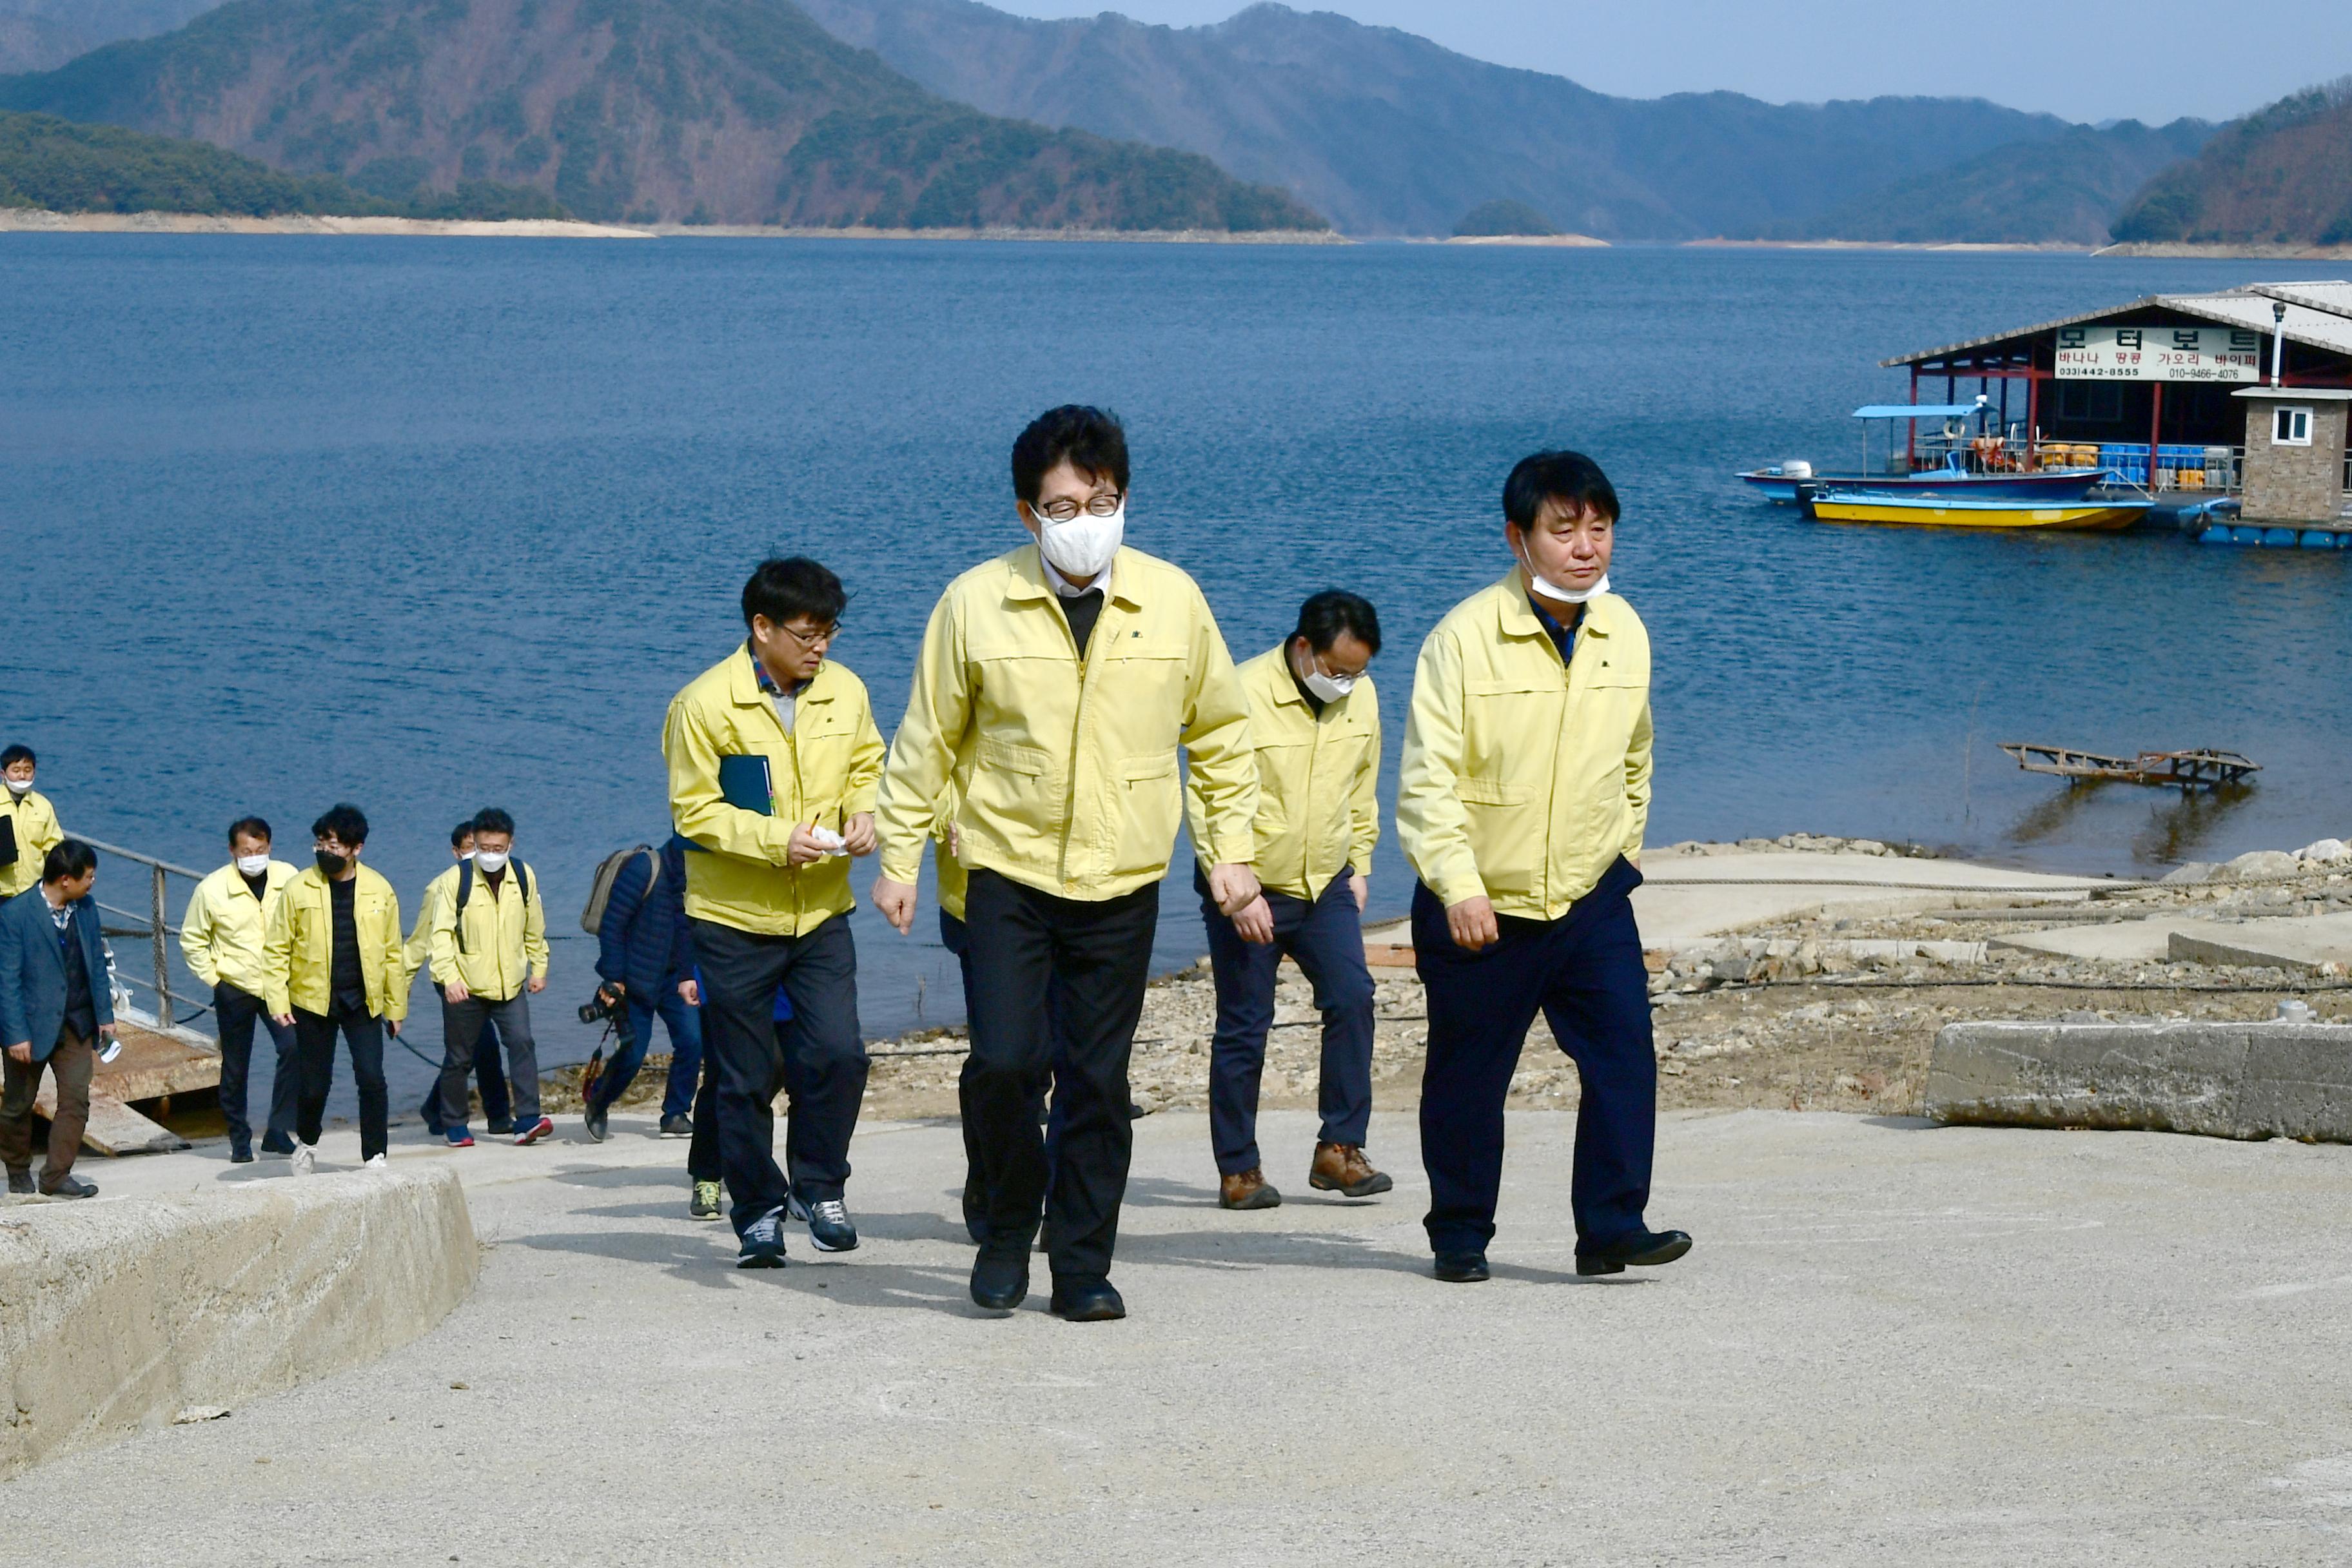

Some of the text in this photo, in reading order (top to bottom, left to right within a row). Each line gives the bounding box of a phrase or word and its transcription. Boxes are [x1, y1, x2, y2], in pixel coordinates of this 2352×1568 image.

[2059, 352, 2257, 367] 바나나 땅콩 가오리 바이퍼
[2059, 368, 2239, 379] 033)442-8555 010-9466-4076
